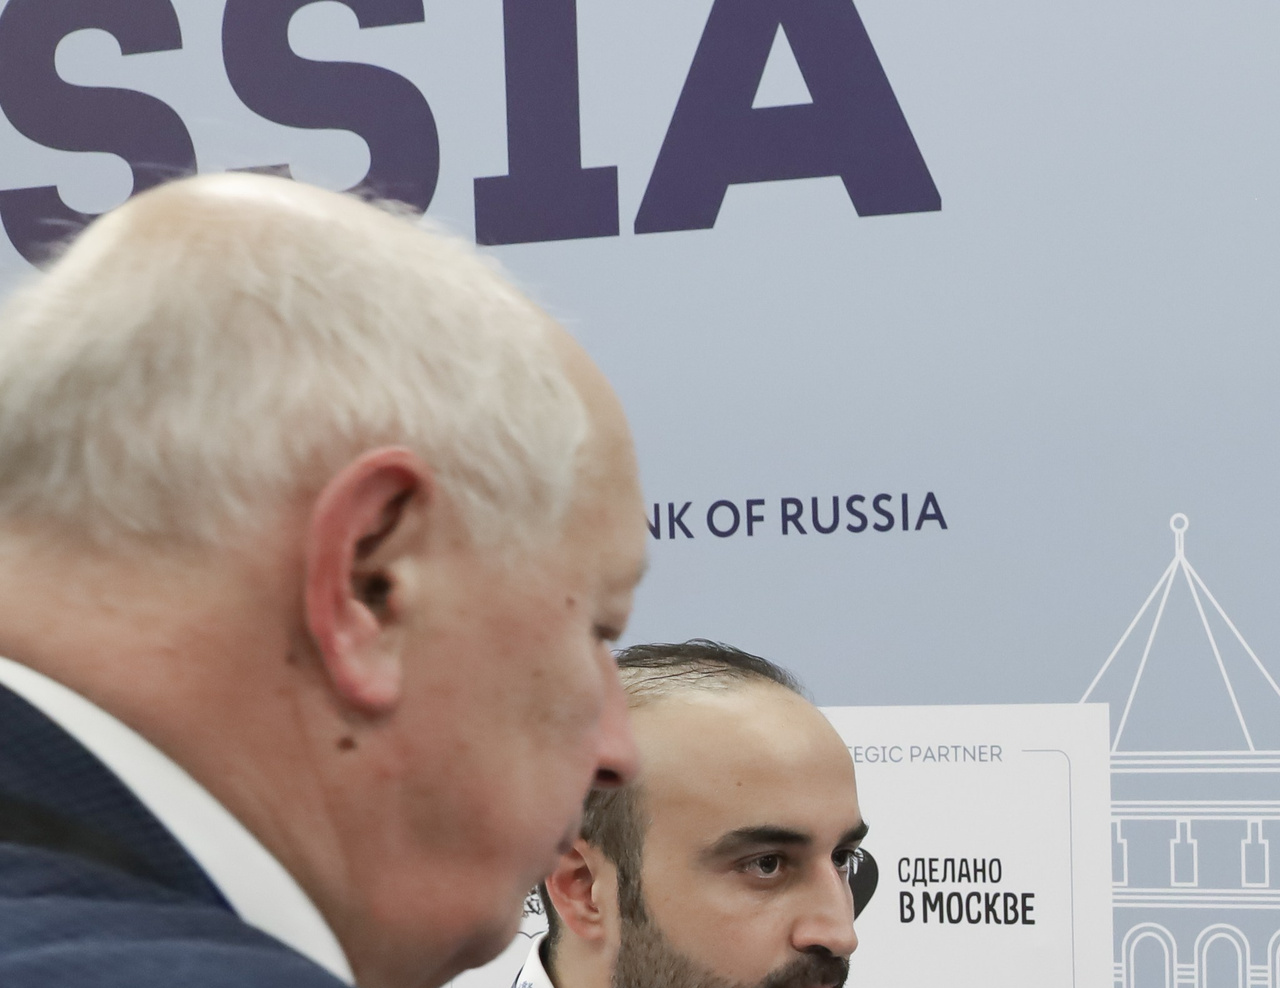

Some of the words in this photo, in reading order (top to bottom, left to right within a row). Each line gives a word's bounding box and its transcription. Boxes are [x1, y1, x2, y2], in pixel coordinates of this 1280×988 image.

[706, 499, 765, 538] OF
[780, 491, 949, 536] RUSSIA
[848, 745, 904, 763] EGIC
[910, 744, 1003, 763] PARTNER
[897, 857, 1003, 887] СДЕЛАНО
[899, 891, 915, 924] В
[922, 891, 1036, 925] МОСКВЕ
